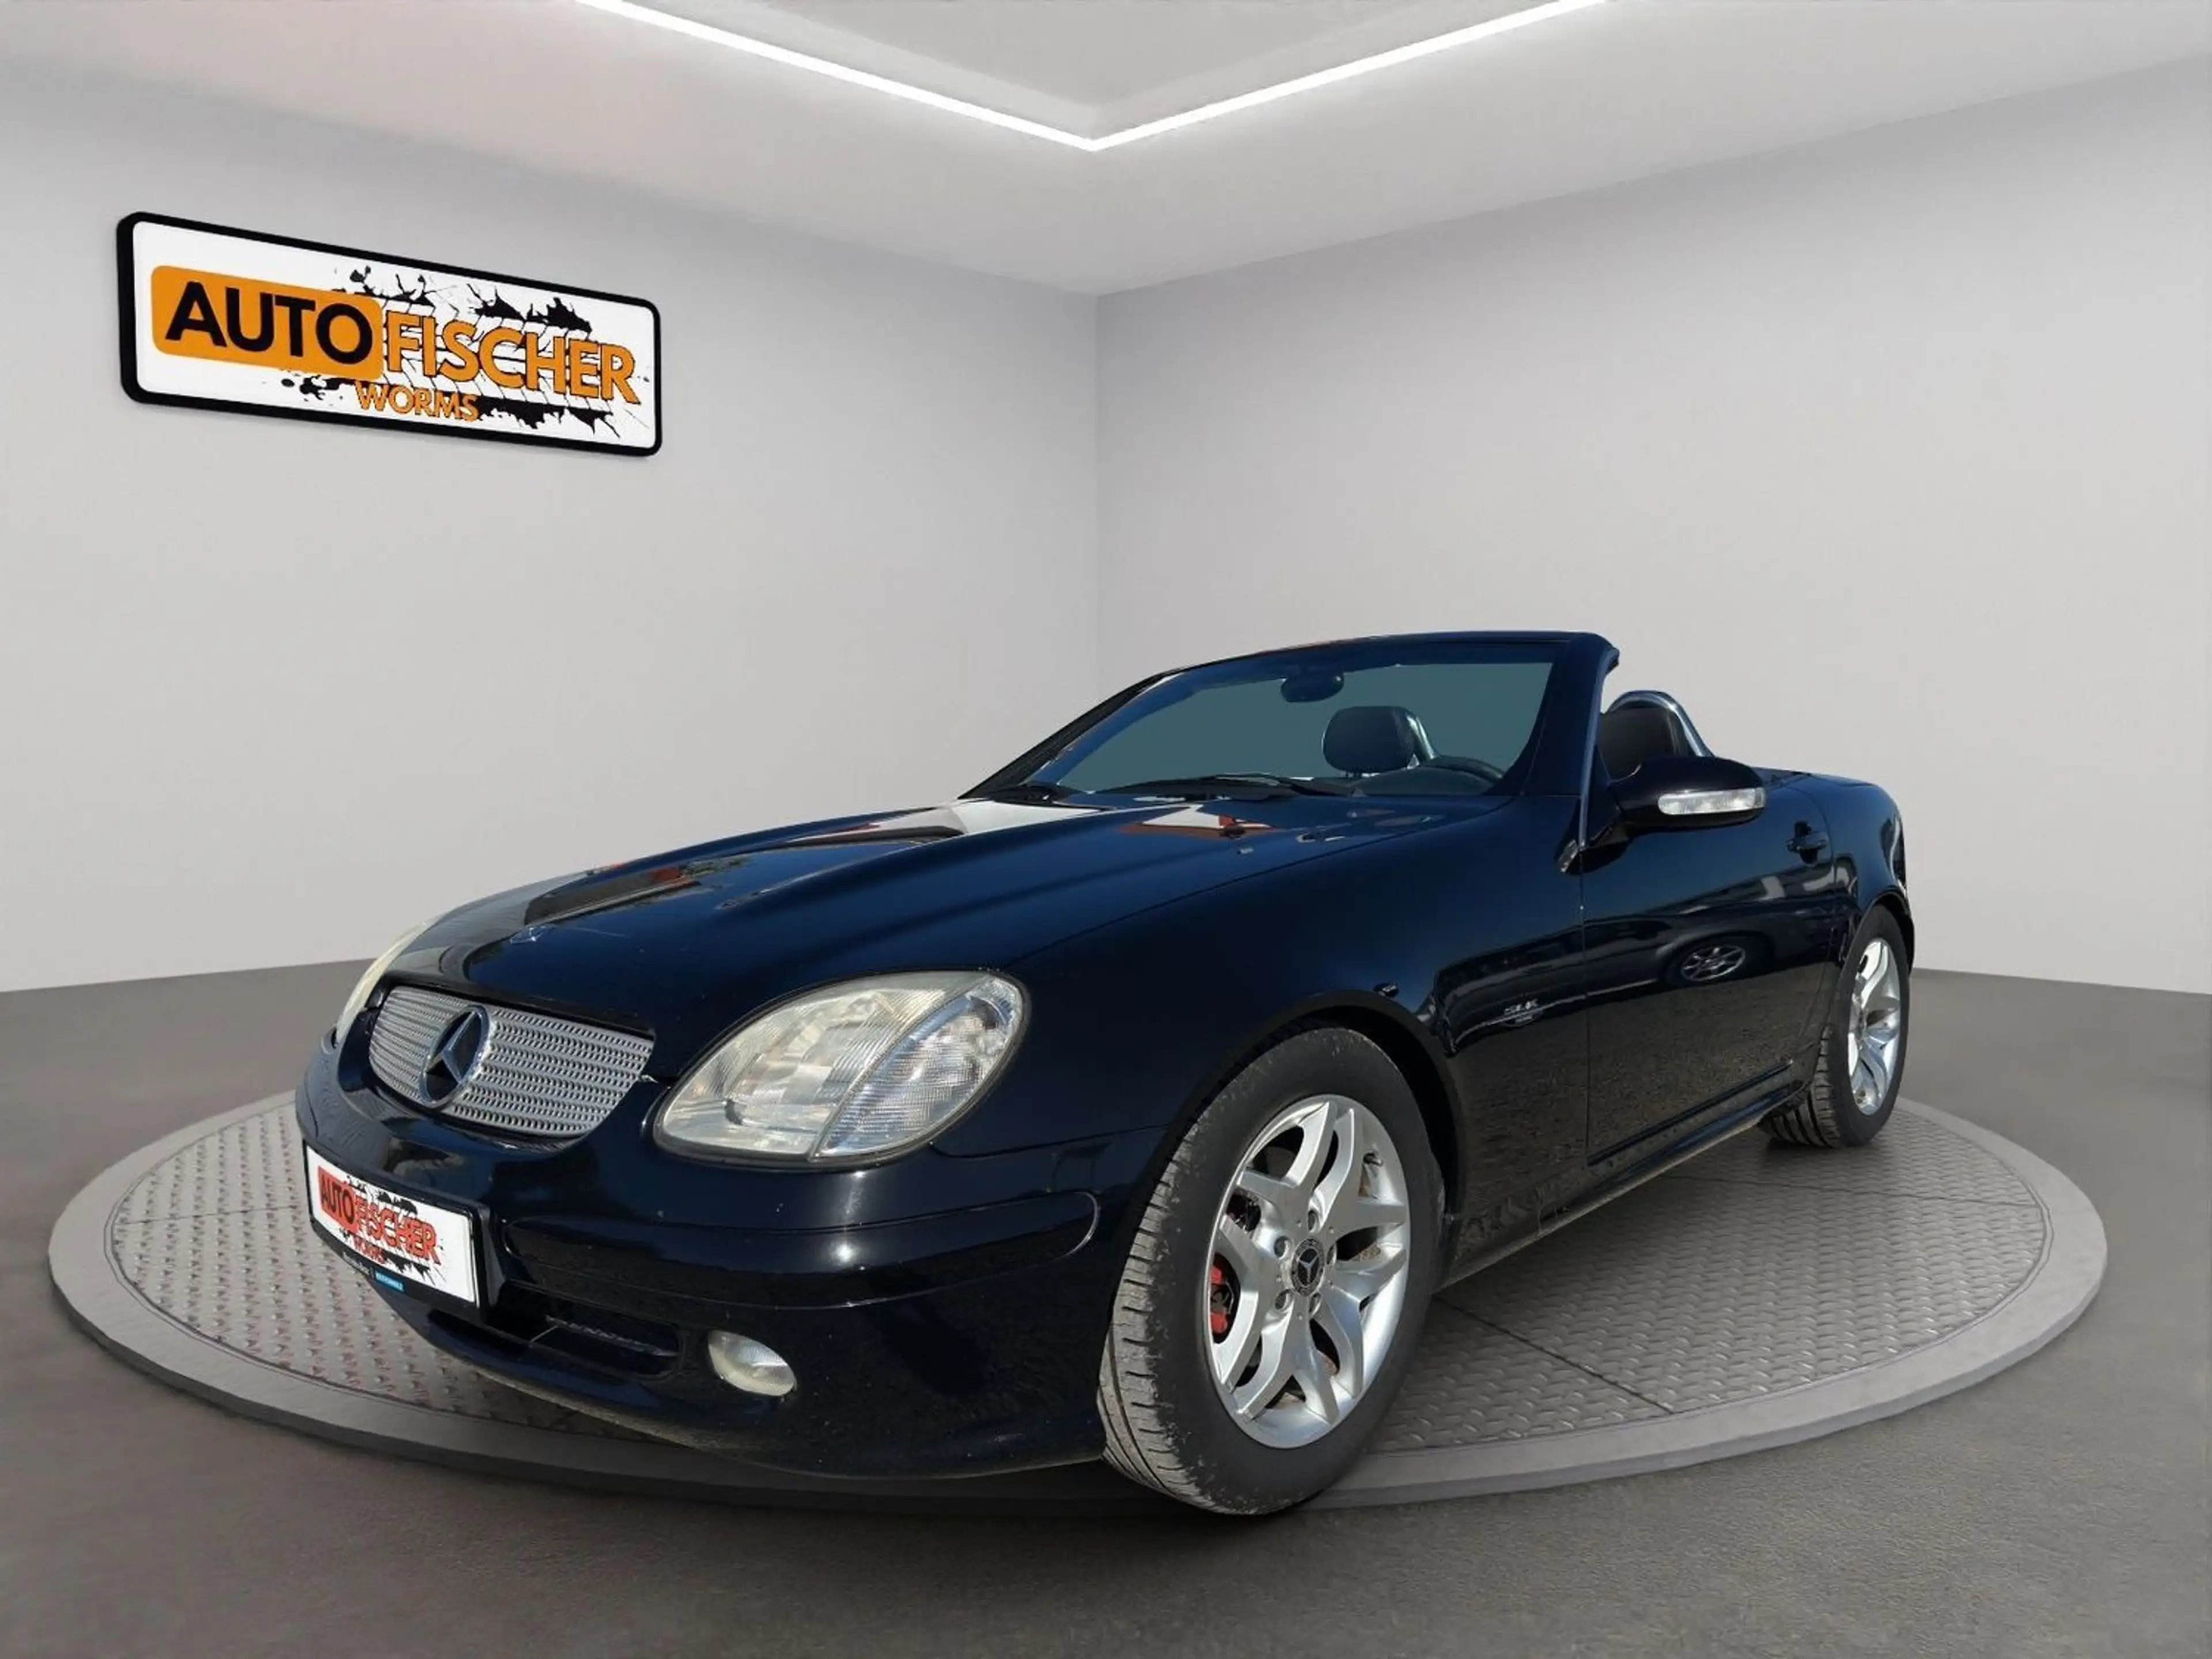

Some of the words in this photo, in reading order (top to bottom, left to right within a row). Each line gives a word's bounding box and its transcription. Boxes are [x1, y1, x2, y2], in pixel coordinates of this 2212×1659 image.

[165, 281, 373, 365] AUTO
[386, 310, 642, 406] FISCHER
[355, 380, 479, 422] WORMS
[321, 1175, 355, 1224] AUTO
